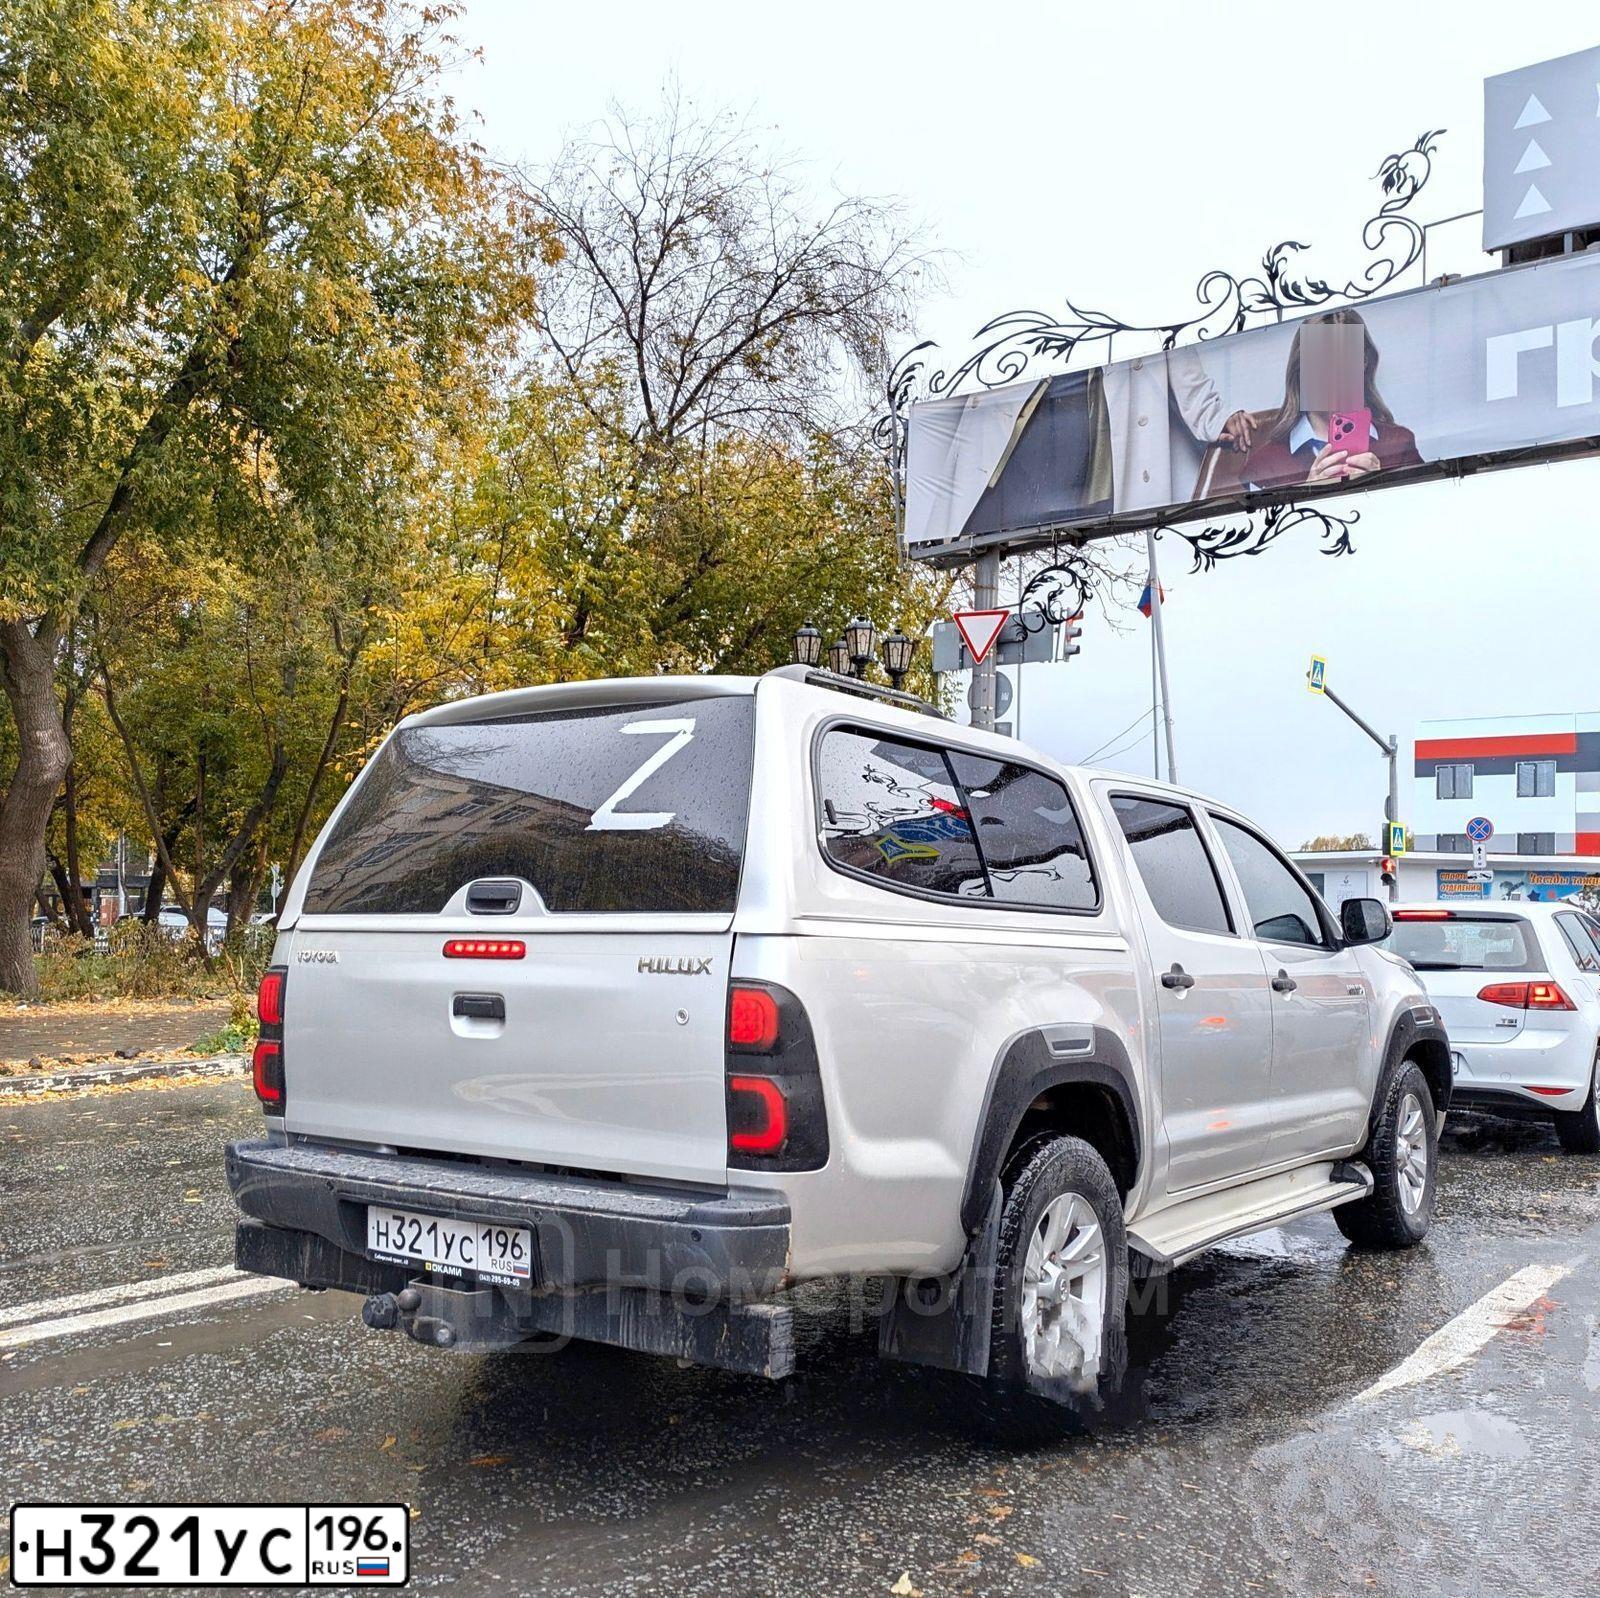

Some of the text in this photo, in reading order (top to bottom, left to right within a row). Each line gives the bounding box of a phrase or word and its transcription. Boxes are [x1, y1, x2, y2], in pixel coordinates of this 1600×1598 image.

[584, 717, 696, 831] Z
[297, 950, 340, 964] TOYOTA
[637, 956, 713, 976] HILUX
[376, 1215, 524, 1264] Н321УС 196
[432, 1263, 462, 1277] ОКАМИ
[491, 1259, 513, 1272] RUS
